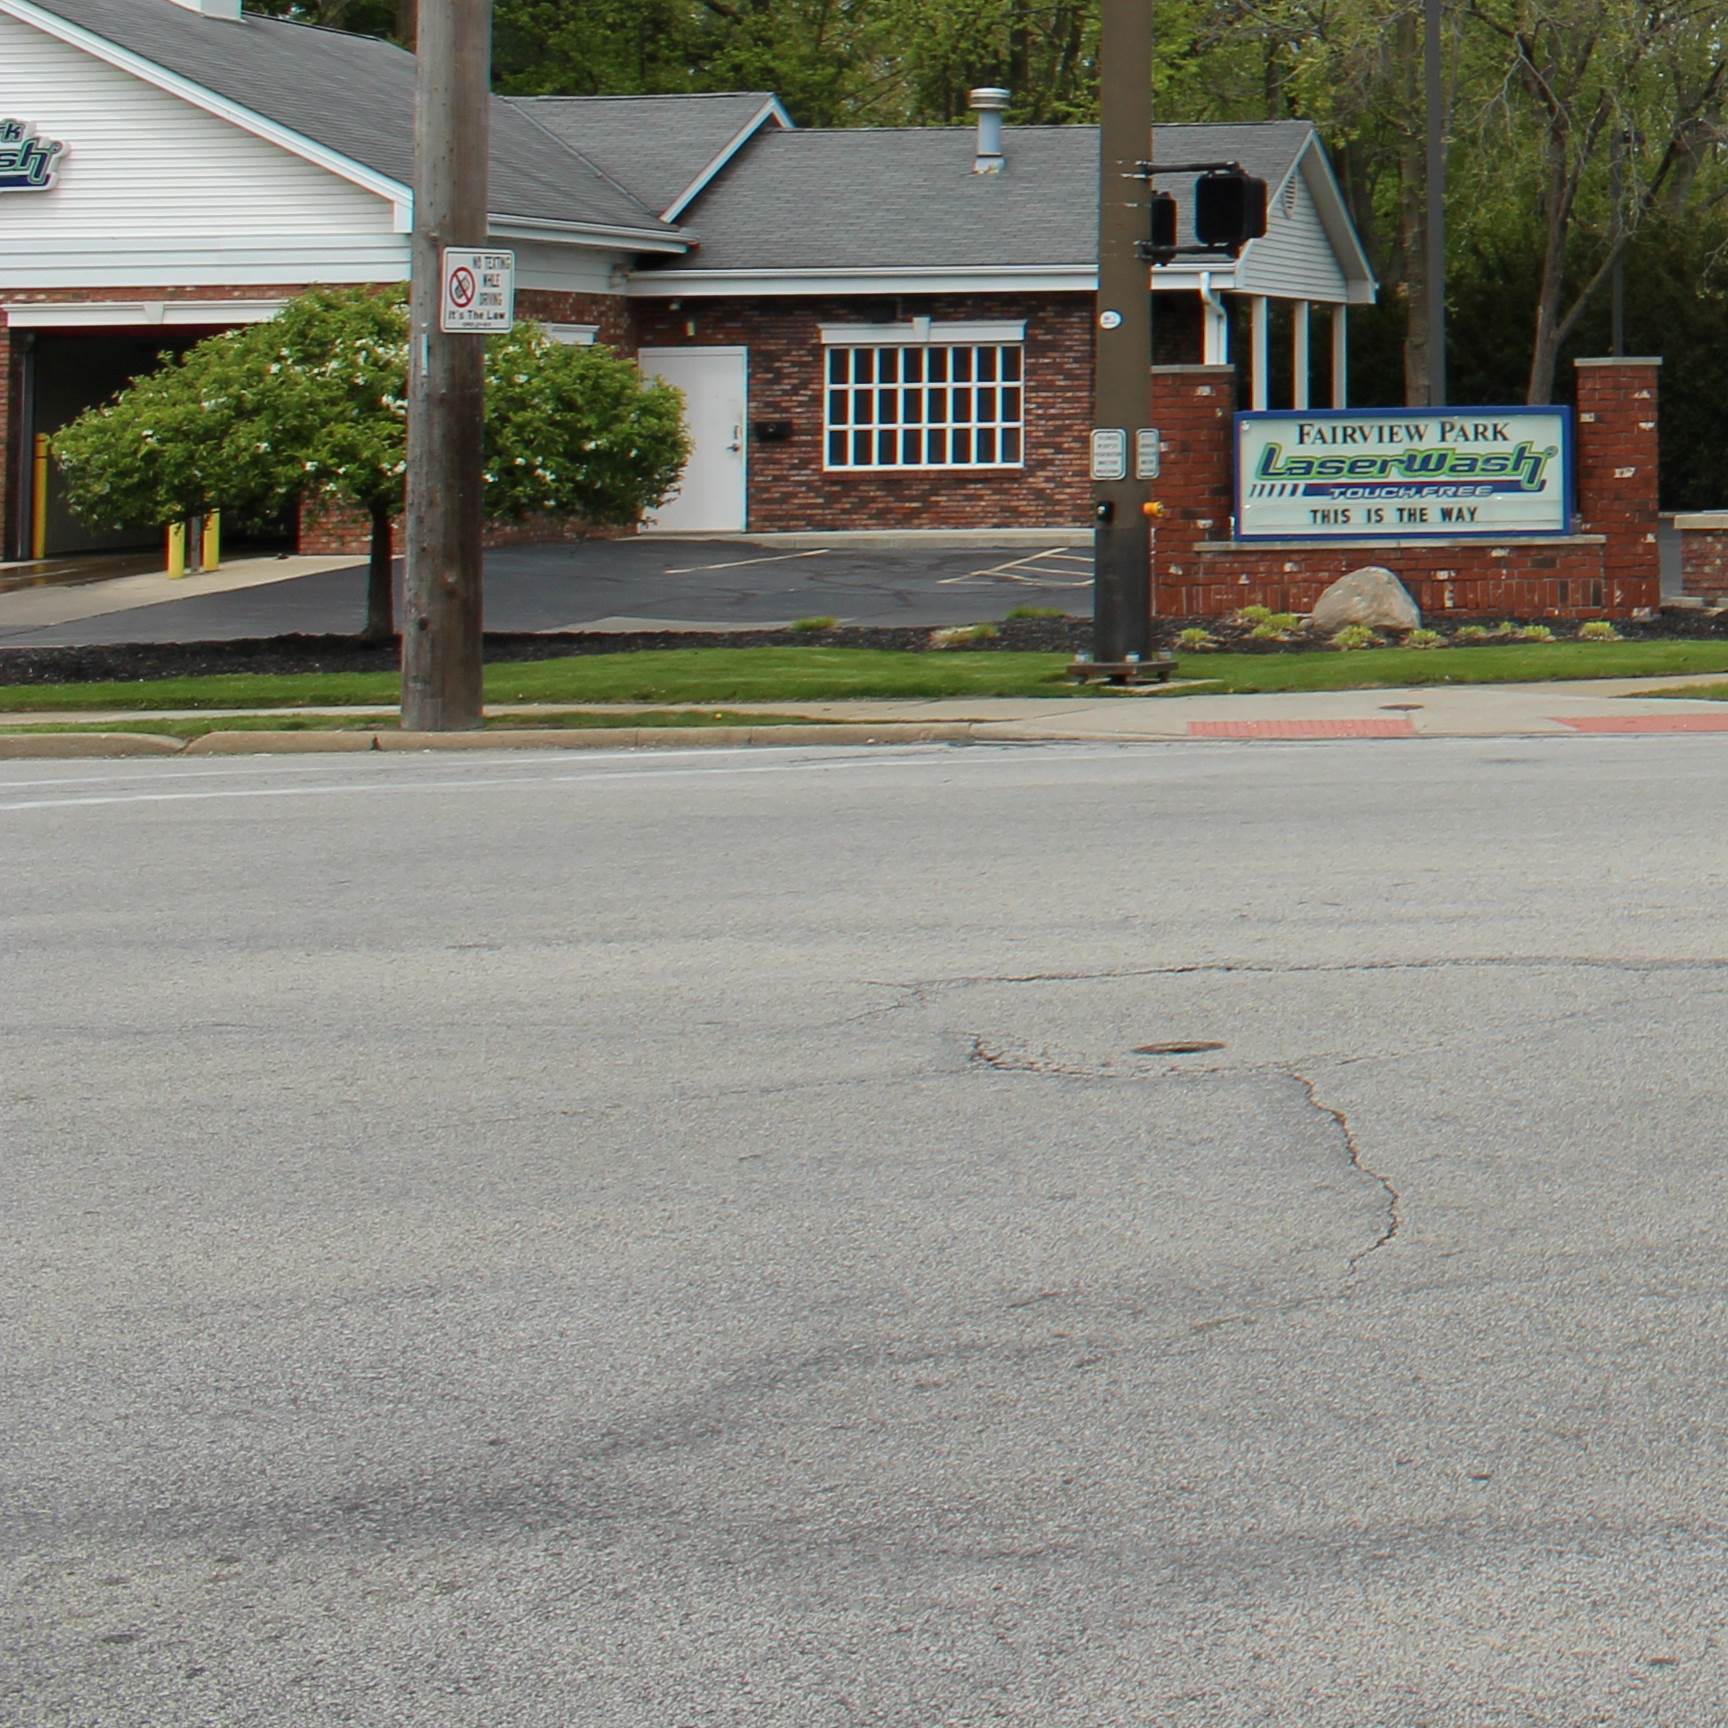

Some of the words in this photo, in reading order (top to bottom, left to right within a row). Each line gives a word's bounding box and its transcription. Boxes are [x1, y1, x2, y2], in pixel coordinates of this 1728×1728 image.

[1297, 423, 1428, 445] FAIRVIEW
[1439, 420, 1510, 442] PARK
[1310, 508, 1351, 524] THIS
[1367, 508, 1384, 523] IS
[1397, 507, 1428, 523] THE
[1441, 506, 1478, 522] WAY
